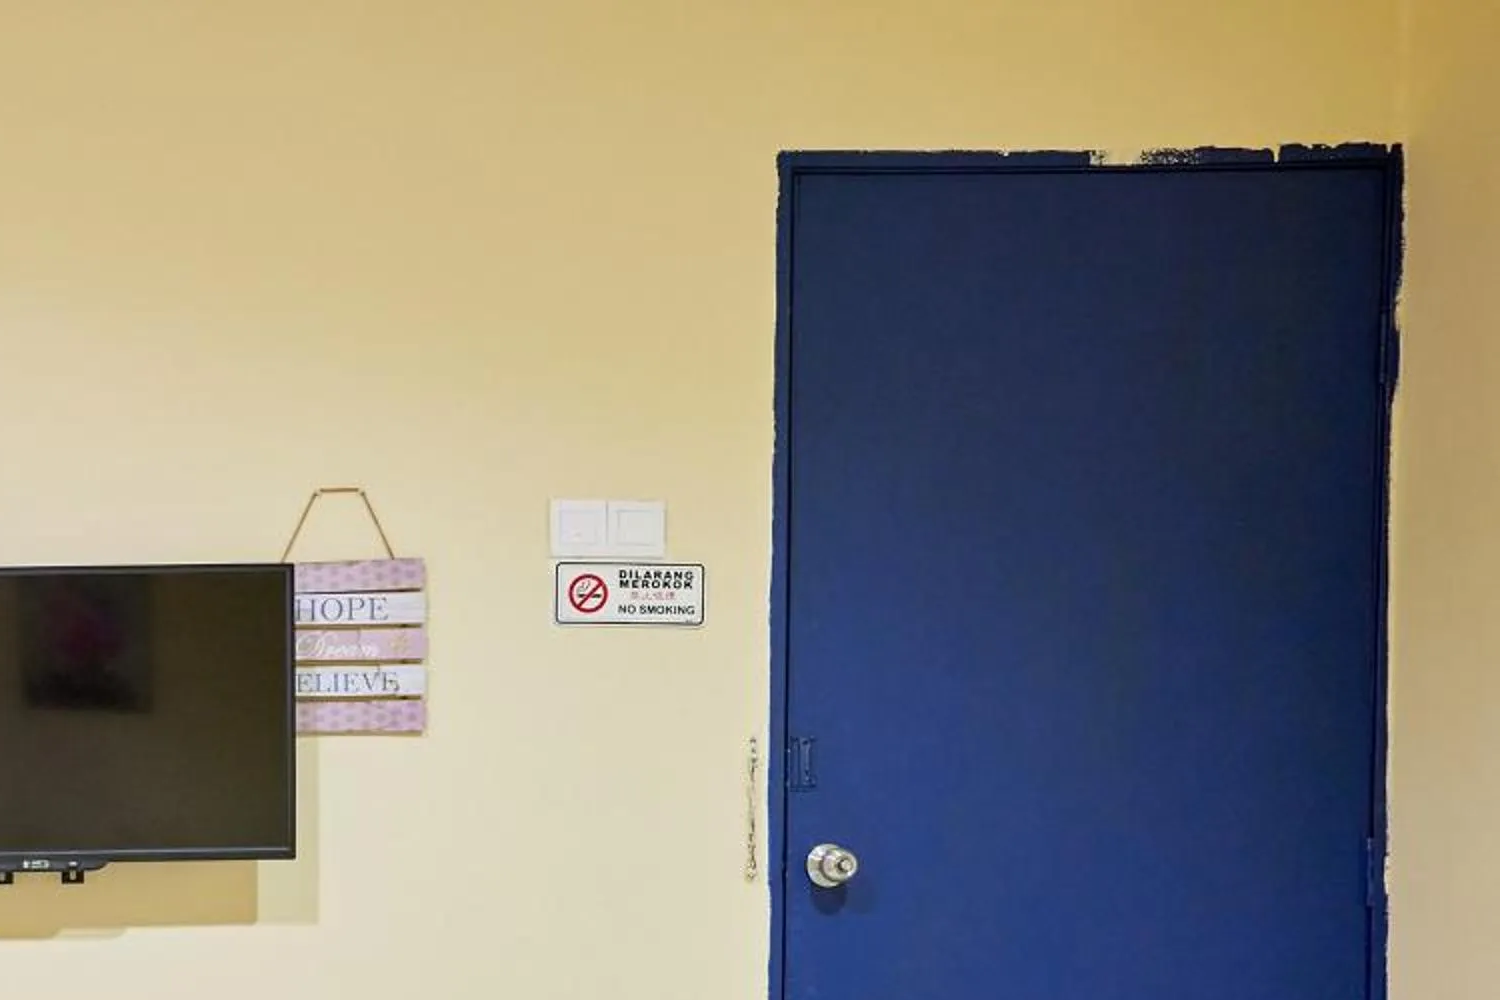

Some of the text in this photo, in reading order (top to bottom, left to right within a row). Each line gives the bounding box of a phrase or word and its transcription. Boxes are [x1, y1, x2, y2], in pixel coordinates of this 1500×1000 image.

[619, 570, 694, 580] DILARANG
[619, 580, 693, 589] MEROKOK
[296, 597, 389, 622] HOPE
[618, 605, 695, 615] NO SMOKING
[297, 672, 400, 693] ELIEVE
